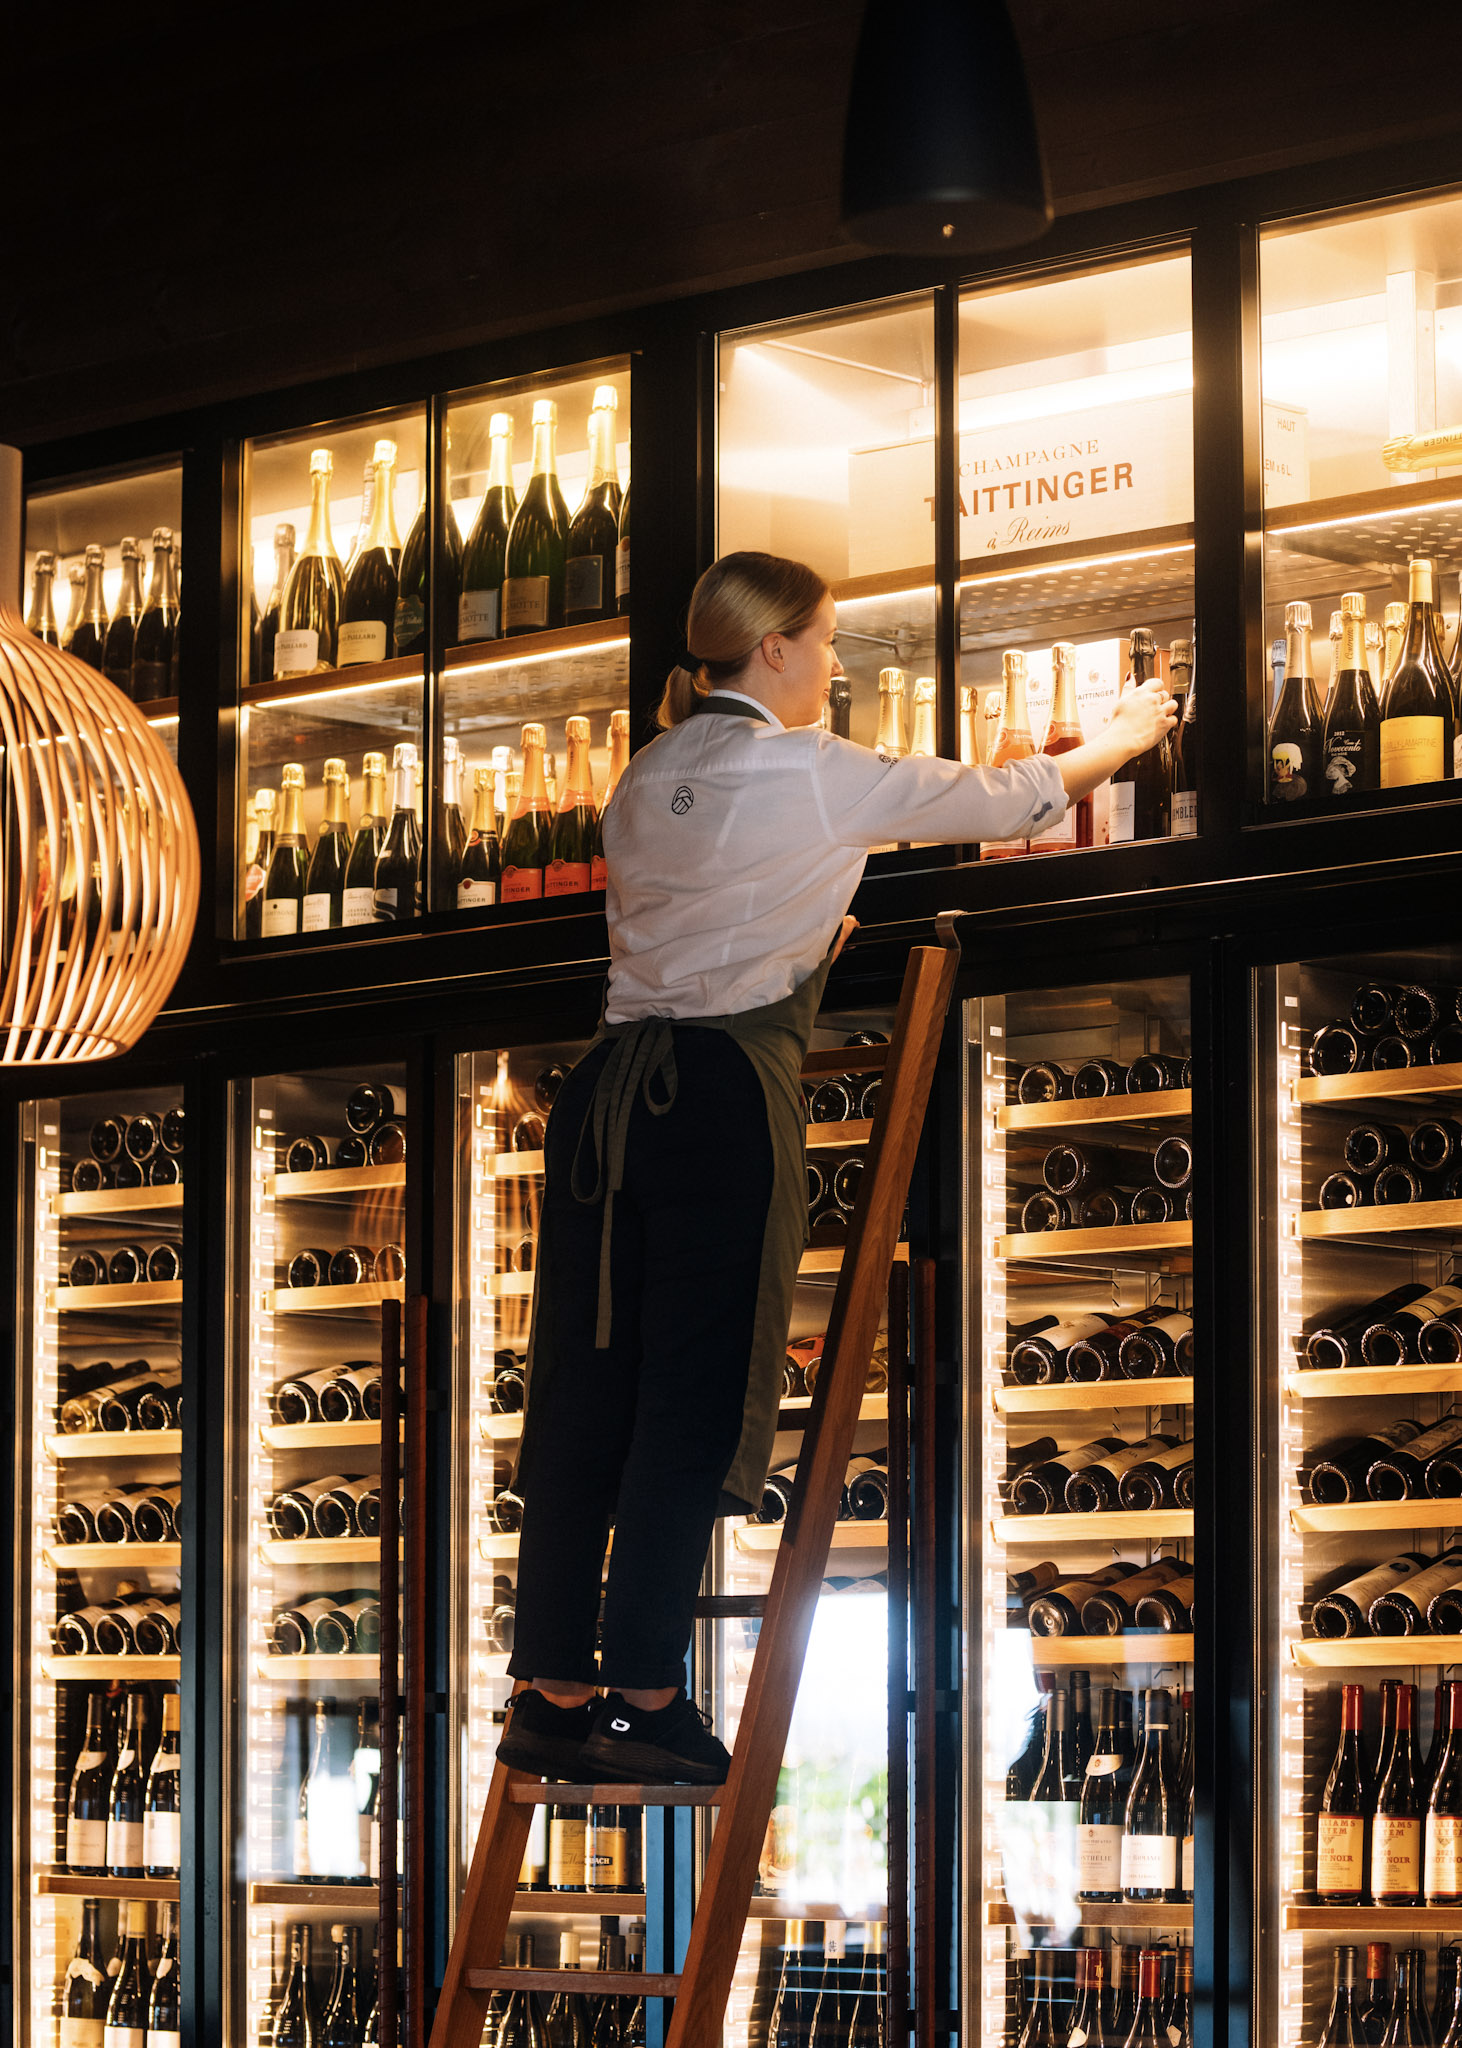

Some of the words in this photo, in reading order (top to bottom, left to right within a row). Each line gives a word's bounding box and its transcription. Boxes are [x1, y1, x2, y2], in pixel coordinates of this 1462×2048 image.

[1277, 418, 1296, 432] HAUT
[959, 439, 1099, 478] CHAMPAGNE
[1001, 515, 1071, 546] Reims
[1076, 689, 1115, 701] AITTINGER
[1330, 1854, 1354, 1862] NOIR
